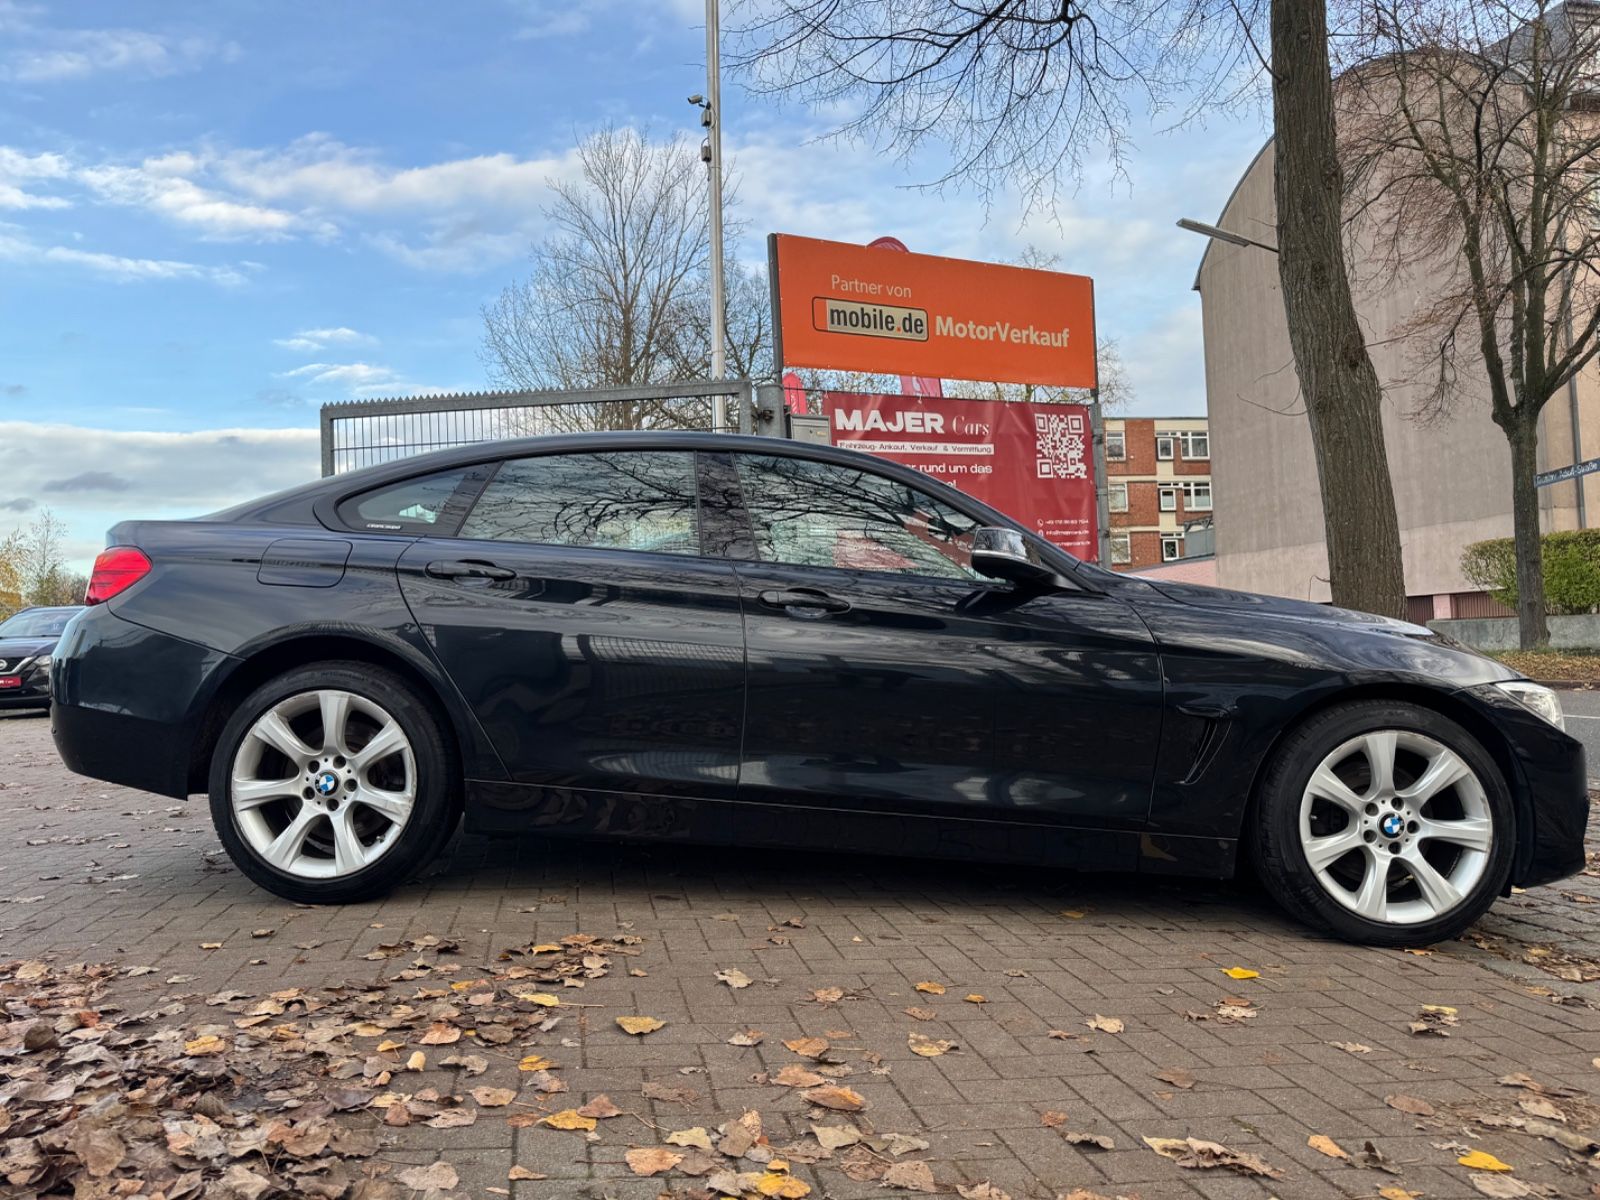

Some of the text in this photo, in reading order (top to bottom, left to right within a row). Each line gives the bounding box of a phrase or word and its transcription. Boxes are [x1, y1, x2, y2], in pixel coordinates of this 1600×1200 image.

[831, 274, 912, 298] Partner von
[830, 307, 924, 335] mobile.de
[935, 315, 1070, 348] MotorVerkauf
[834, 408, 990, 436] MAJER Cars
[919, 462, 946, 473] rund
[948, 465, 968, 474] um
[970, 463, 993, 474] das
